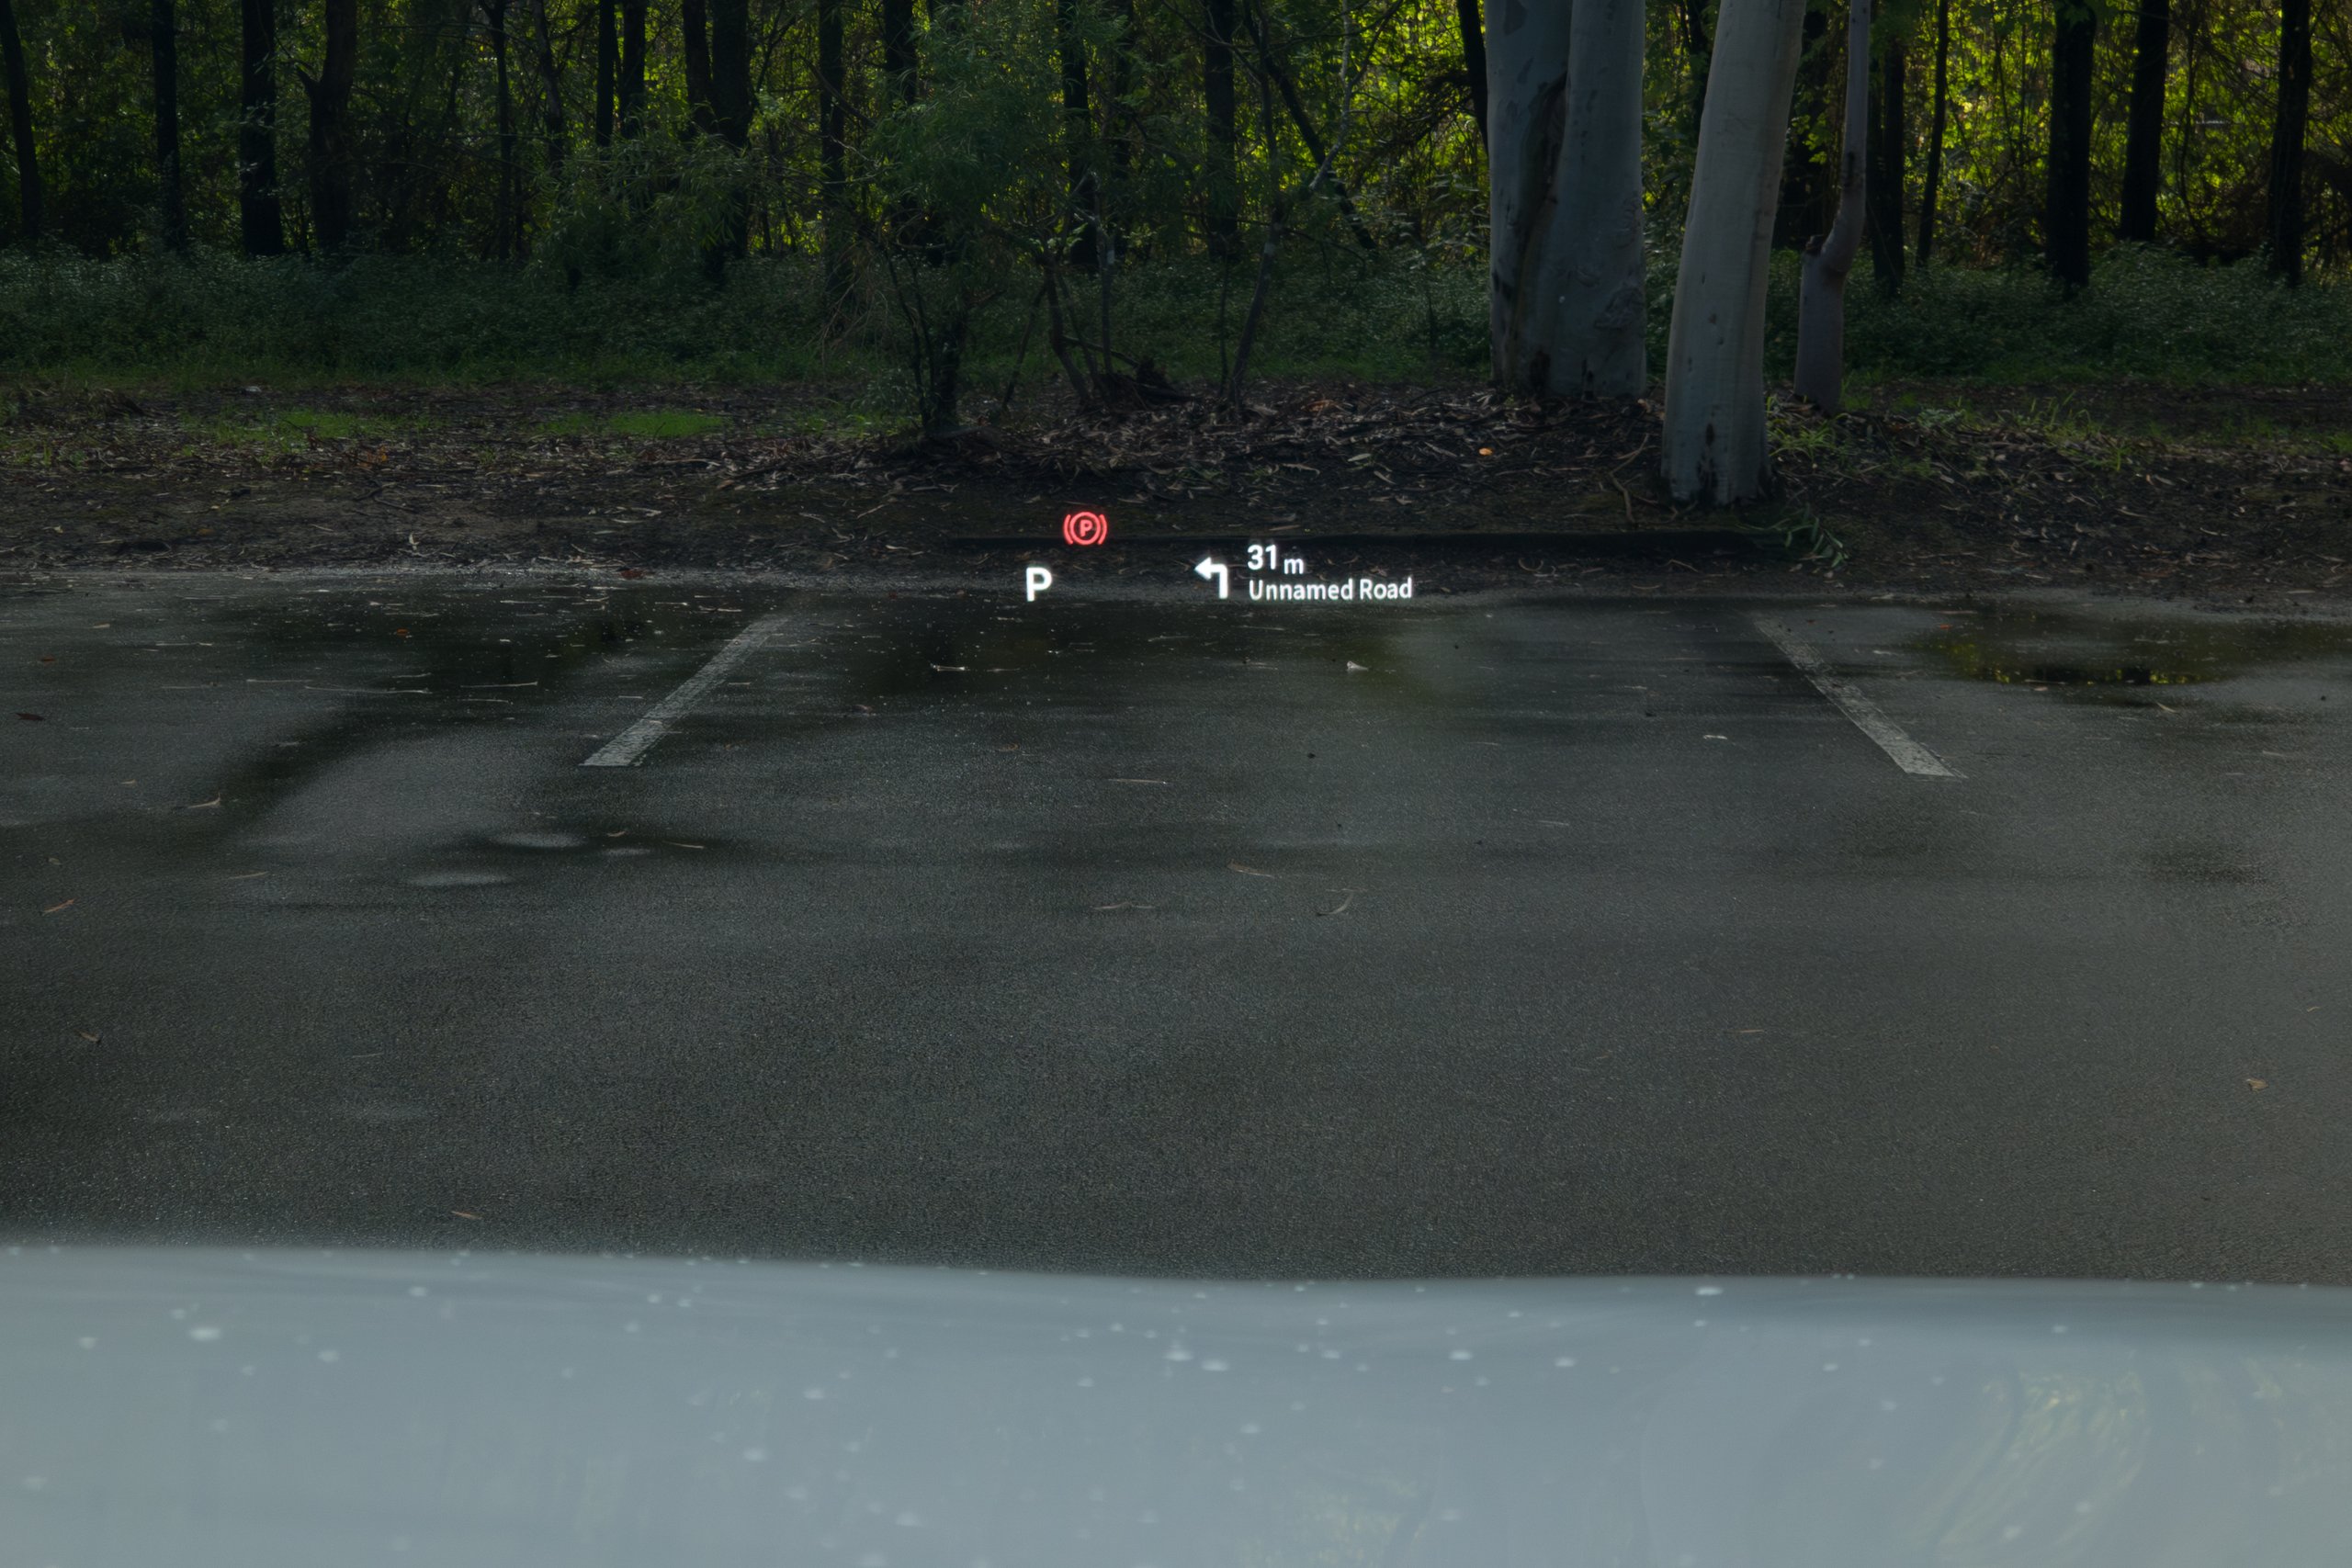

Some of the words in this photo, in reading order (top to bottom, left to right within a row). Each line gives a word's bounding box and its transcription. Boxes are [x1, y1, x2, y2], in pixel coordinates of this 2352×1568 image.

[1080, 519, 1093, 537] P
[1247, 544, 1277, 570] 31
[1283, 558, 1305, 575] m
[1025, 567, 1053, 602] P
[1249, 577, 1353, 601] Unnamed
[1359, 576, 1413, 600] Road
